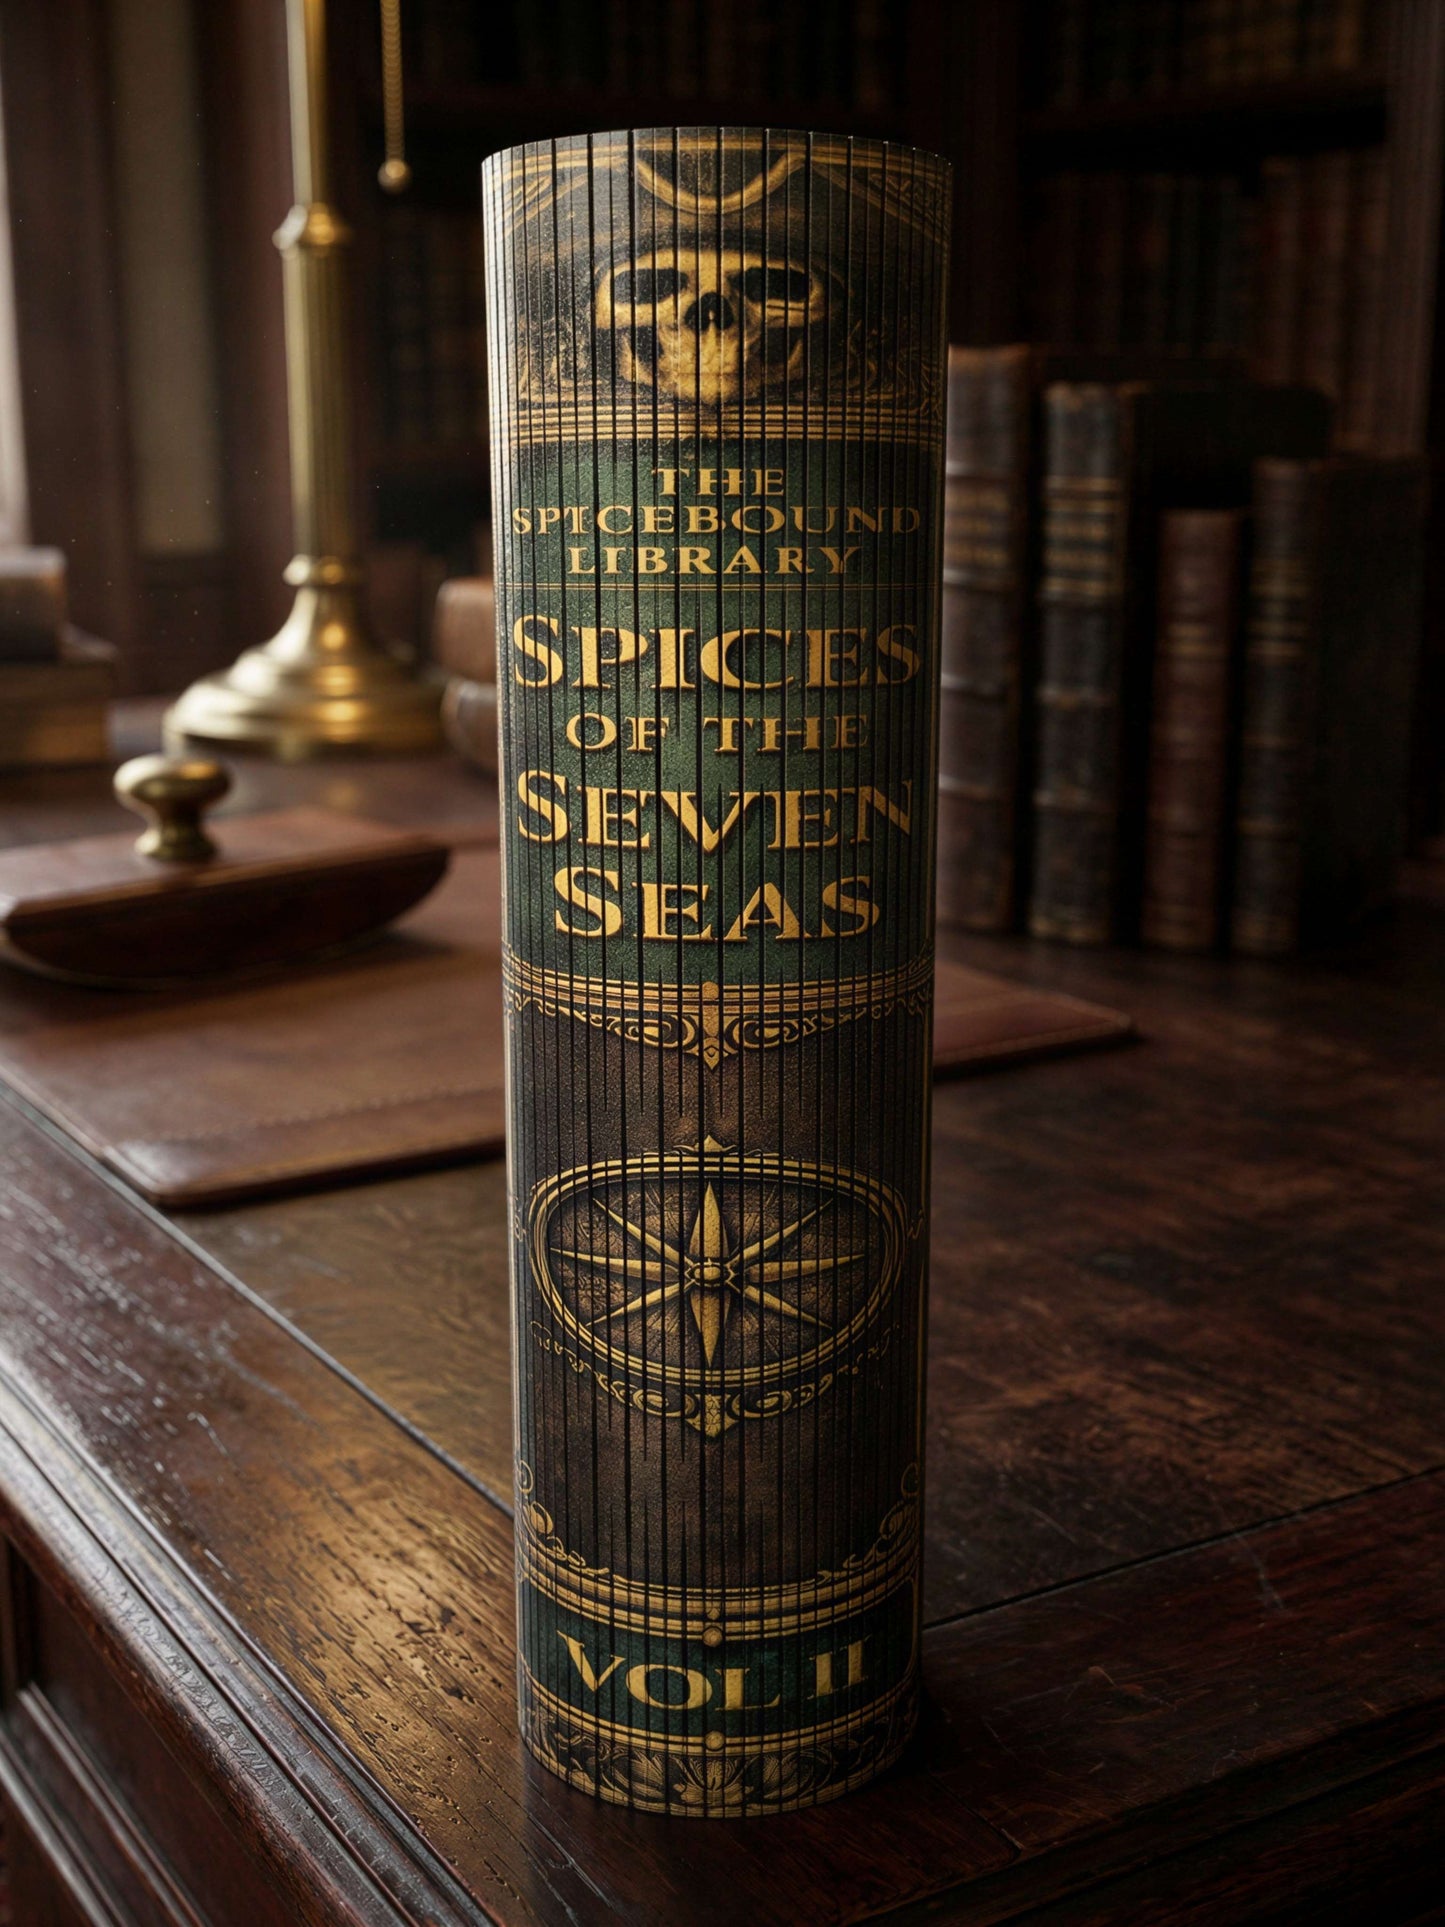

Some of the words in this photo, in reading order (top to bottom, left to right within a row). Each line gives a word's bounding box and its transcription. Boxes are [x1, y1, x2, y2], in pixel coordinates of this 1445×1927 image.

[652, 468, 784, 496] THE
[513, 505, 921, 534] SPICEBOUND
[567, 546, 862, 574] LIBRARY
[513, 614, 921, 689] SPICES
[566, 713, 669, 752] OF
[704, 714, 868, 752] THE
[517, 770, 912, 852] SEVEN
[554, 867, 880, 940] SEAS
[556, 1630, 780, 1711] VOL
[801, 1634, 872, 1699] II
